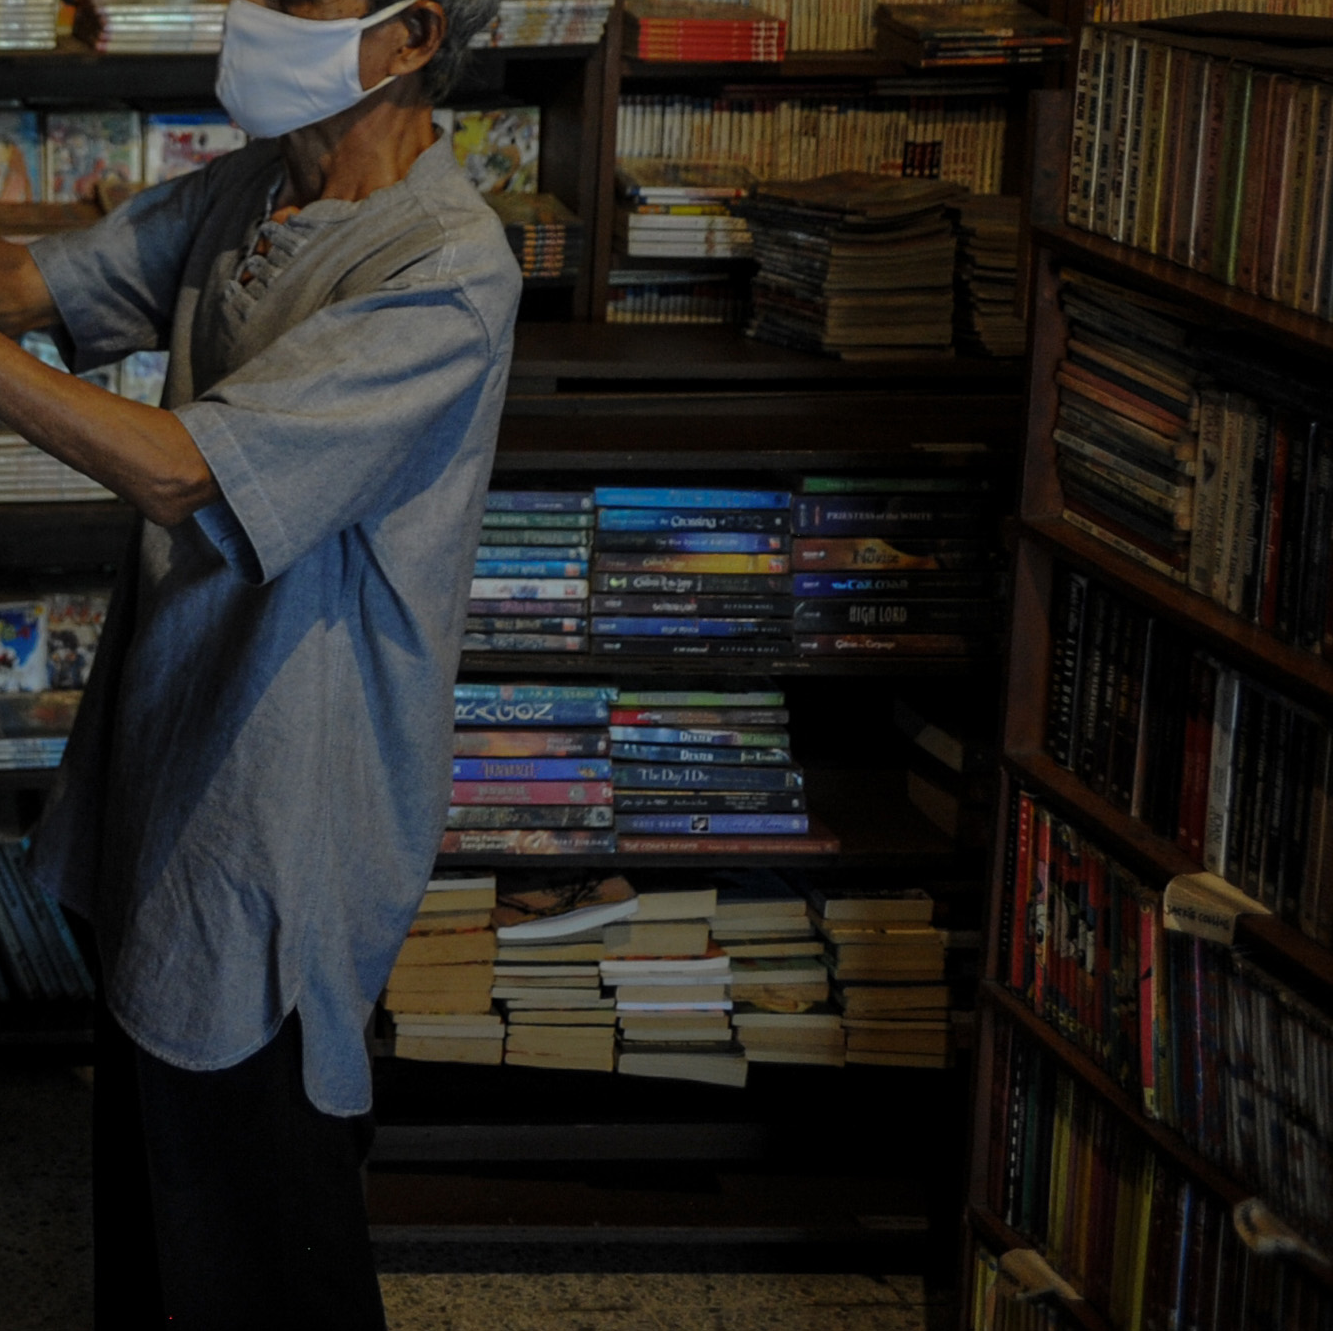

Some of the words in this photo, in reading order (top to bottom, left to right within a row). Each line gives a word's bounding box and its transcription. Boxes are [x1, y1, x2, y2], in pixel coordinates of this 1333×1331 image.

[670, 513, 718, 530] Crossing
[826, 511, 875, 521] PRIESTESS
[848, 605, 875, 626] HIGH
[879, 605, 908, 624] LORD
[453, 701, 554, 725] RAGON
[679, 749, 714, 762] DEXTER
[638, 767, 661, 784] The
